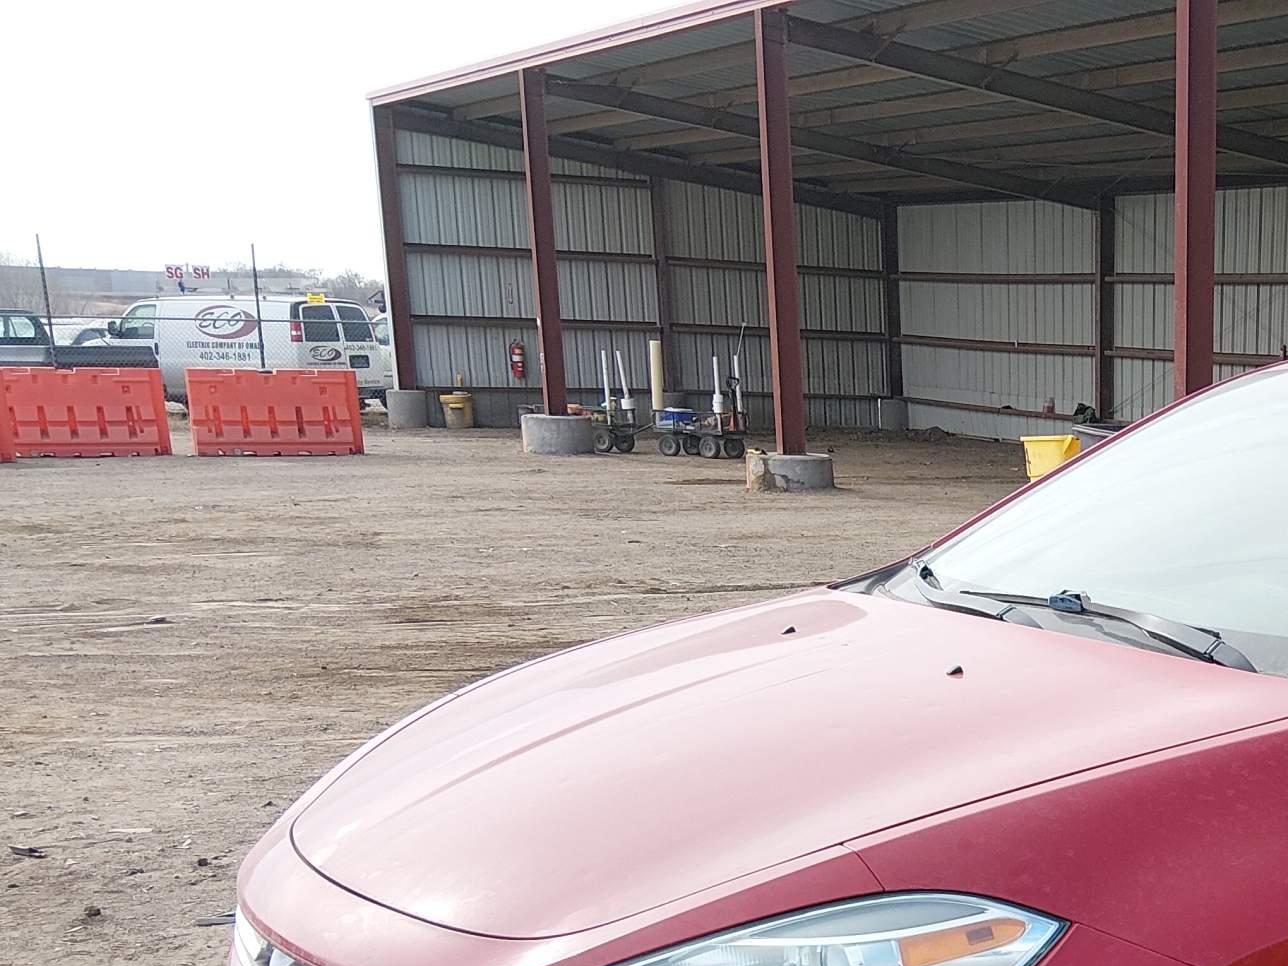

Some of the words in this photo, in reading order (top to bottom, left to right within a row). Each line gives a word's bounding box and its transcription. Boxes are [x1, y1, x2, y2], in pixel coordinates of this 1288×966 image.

[166, 266, 183, 278] SG
[193, 267, 210, 279] SH
[199, 311, 242, 329] ECO
[186, 341, 210, 349] ELECTRIC
[211, 341, 237, 349] COMPANY
